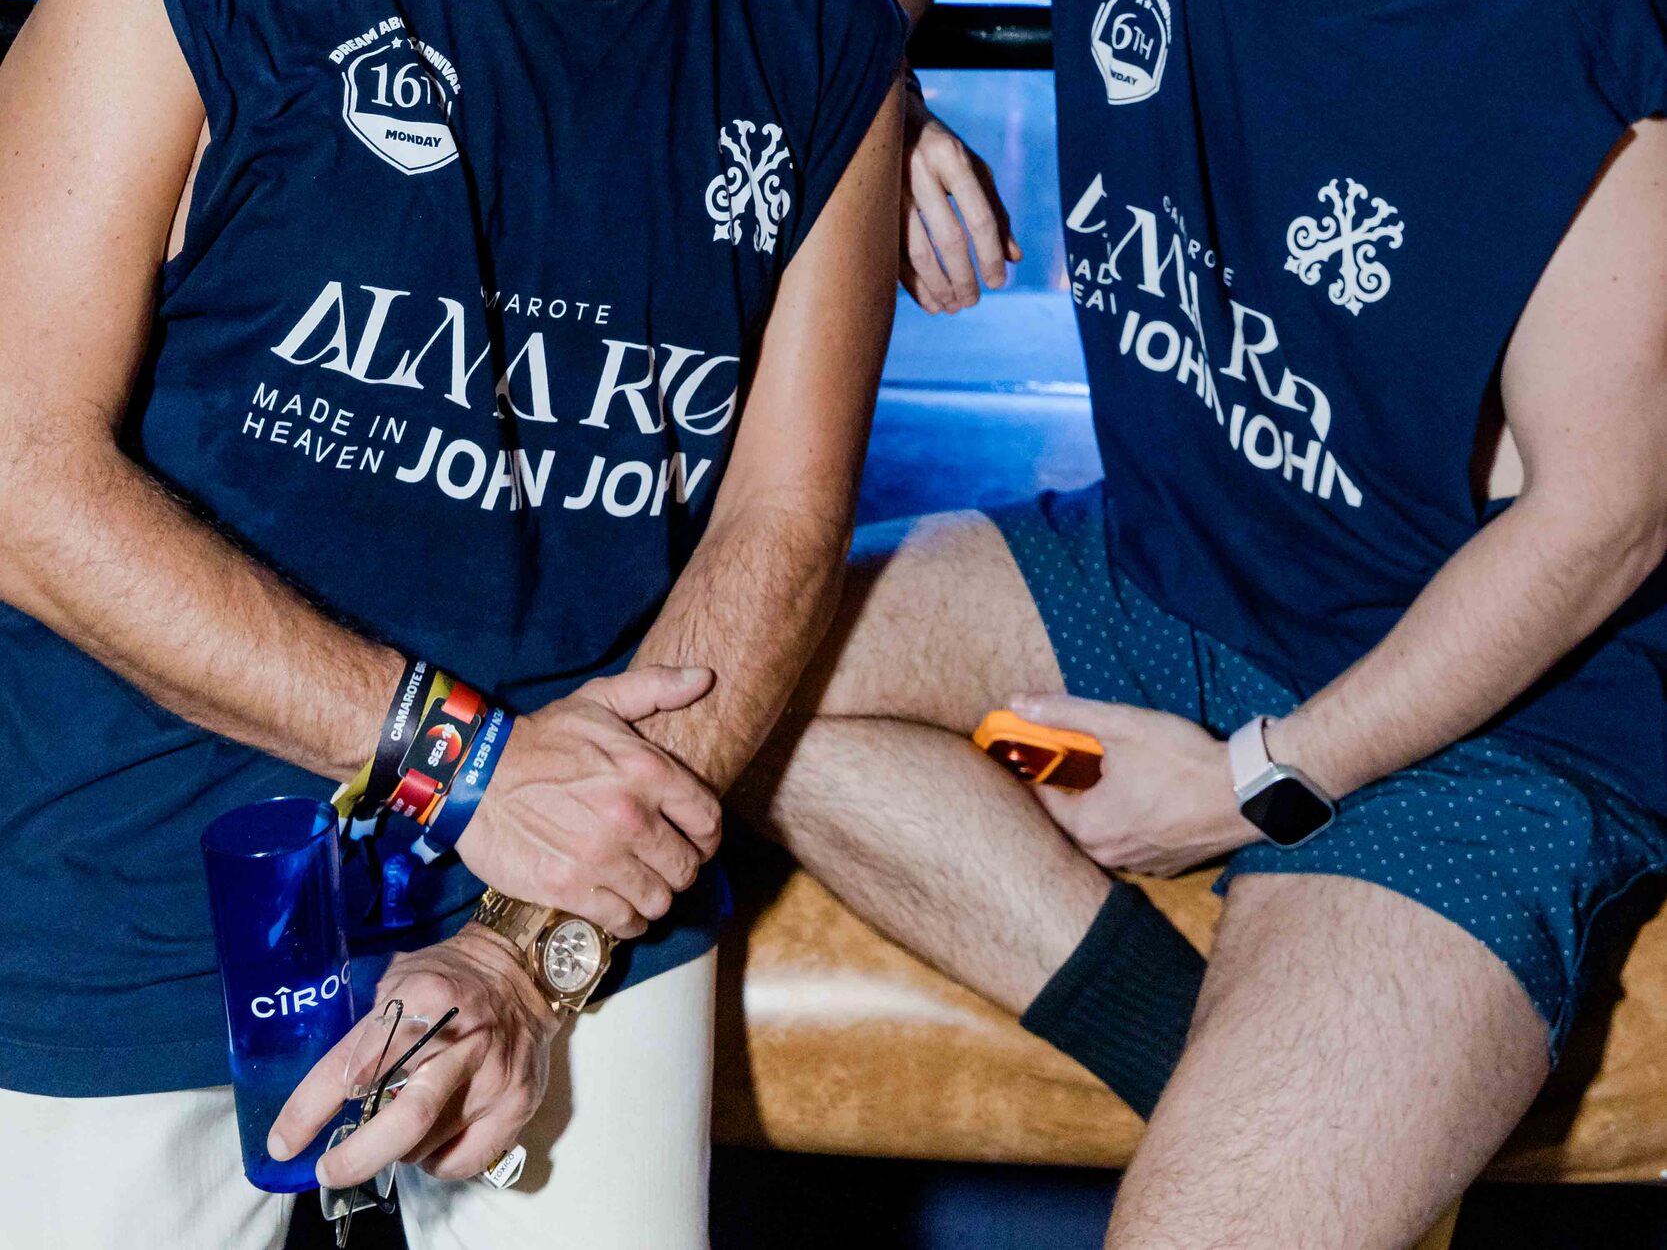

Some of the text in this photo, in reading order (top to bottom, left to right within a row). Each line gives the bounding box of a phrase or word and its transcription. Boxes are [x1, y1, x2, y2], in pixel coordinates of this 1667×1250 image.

[328, 27, 379, 65] DREAM
[385, 129, 442, 148] MONDAY
[252, 382, 408, 444] MADE IN
[242, 411, 385, 474] HEAVEN
[390, 669, 424, 742] CAMAROTE
[427, 739, 449, 768] SEG
[473, 742, 492, 770] SEG
[465, 768, 480, 786] 16
